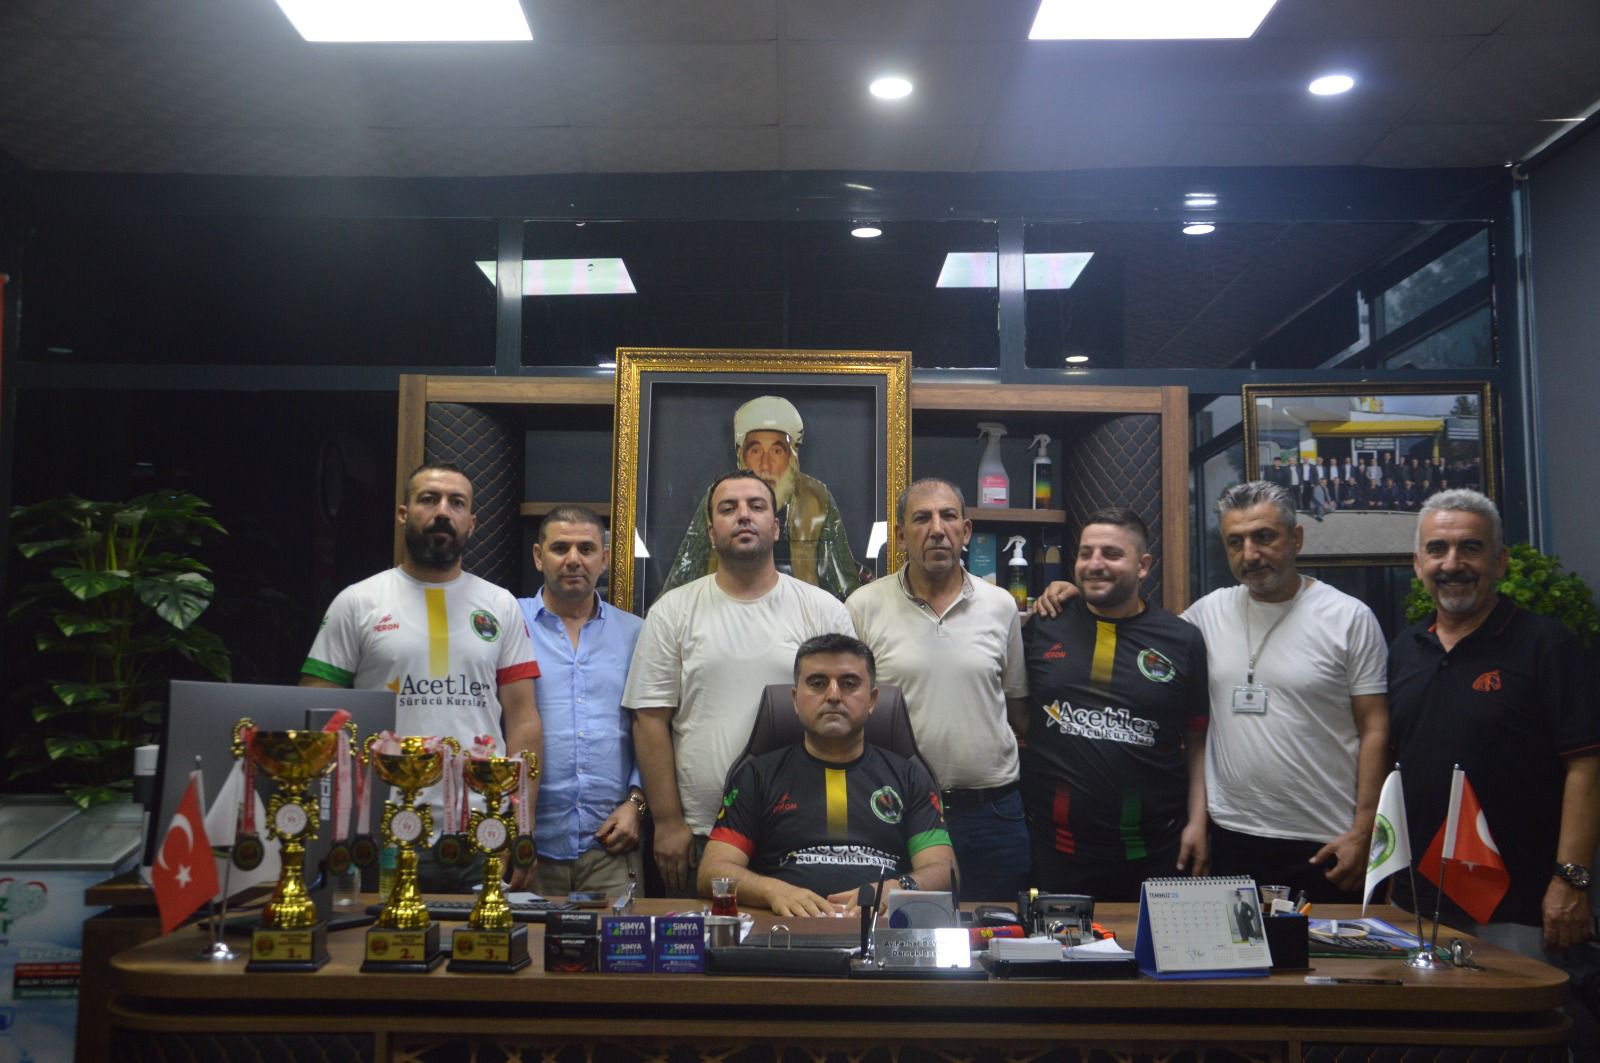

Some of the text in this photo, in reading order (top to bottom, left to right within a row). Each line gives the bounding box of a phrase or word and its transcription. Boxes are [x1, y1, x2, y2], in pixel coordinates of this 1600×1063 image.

[400, 674, 490, 698] Acetler
[399, 696, 442, 707] Sürücü
[1060, 702, 1159, 736] Acetler
